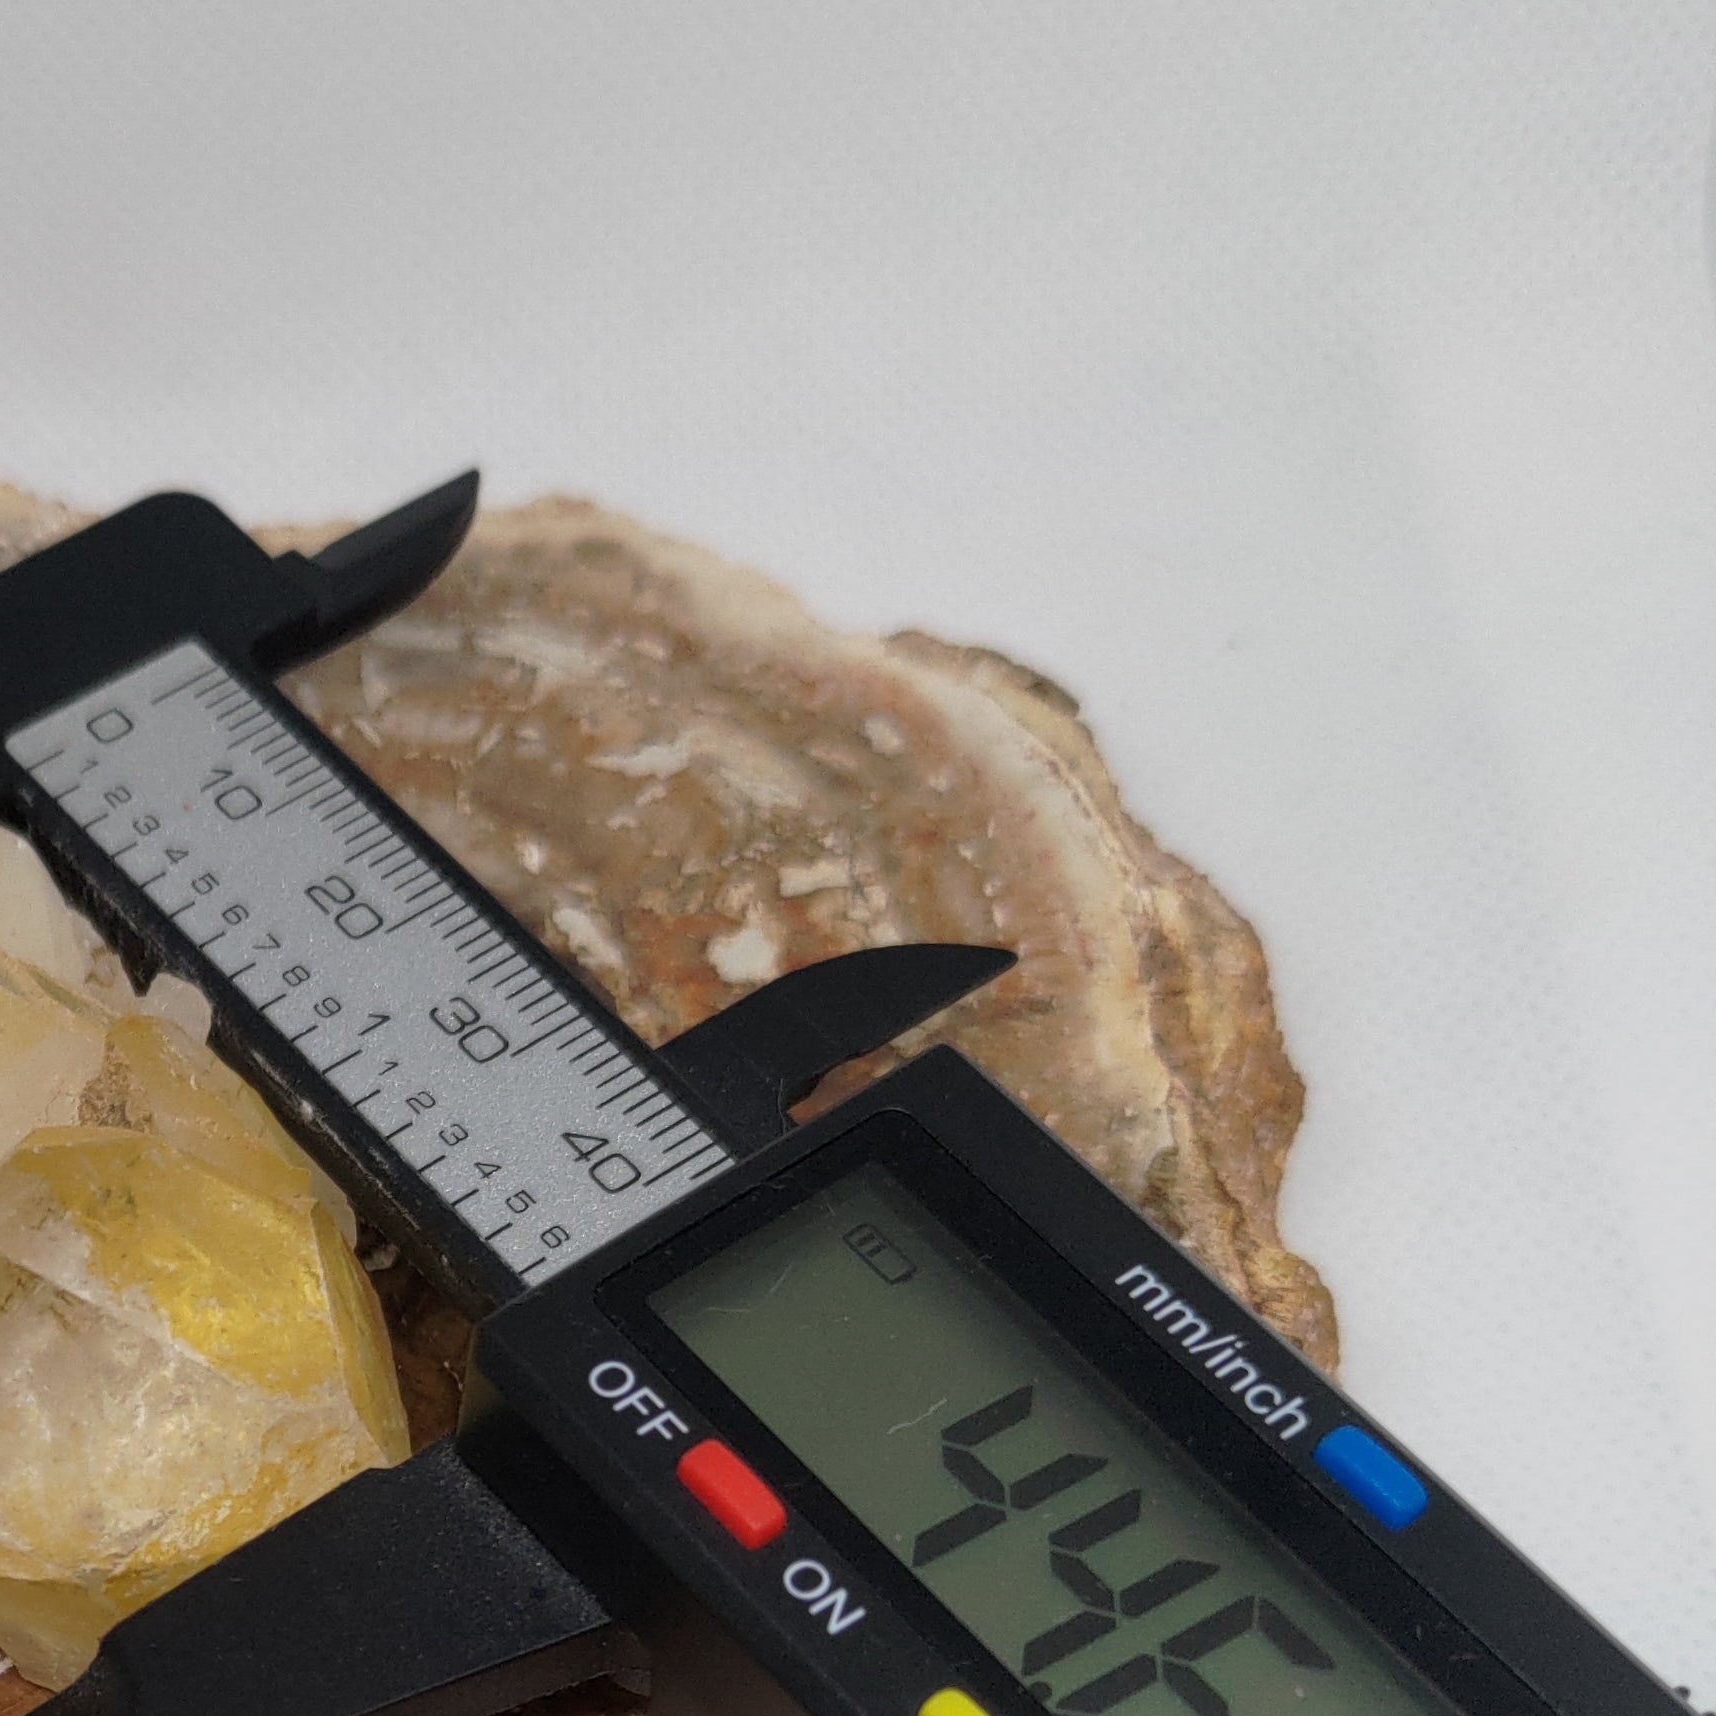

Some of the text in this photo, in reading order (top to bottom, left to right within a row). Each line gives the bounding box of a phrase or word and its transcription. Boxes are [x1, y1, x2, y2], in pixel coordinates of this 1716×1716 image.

[87, 708, 642, 1193] 0 10 20 30 40
[104, 785, 132, 809] 2
[133, 815, 161, 836] 3
[165, 848, 189, 864] 4
[191, 872, 220, 895] 5
[222, 904, 249, 927] 6
[253, 933, 281, 953] 7
[282, 965, 310, 986] 8
[314, 997, 341, 1018] 9
[358, 1013, 390, 1036] 1
[379, 1059, 399, 1076] 1
[405, 1090, 436, 1115] 2
[438, 1123, 469, 1147] 3
[474, 1161, 502, 1179] 4
[505, 1189, 537, 1215] 5
[540, 1225, 570, 1249] 6
[587, 1359, 689, 1446] OFF
[1114, 1262, 1311, 1441] mm/inch
[782, 1559, 866, 1637] ON
